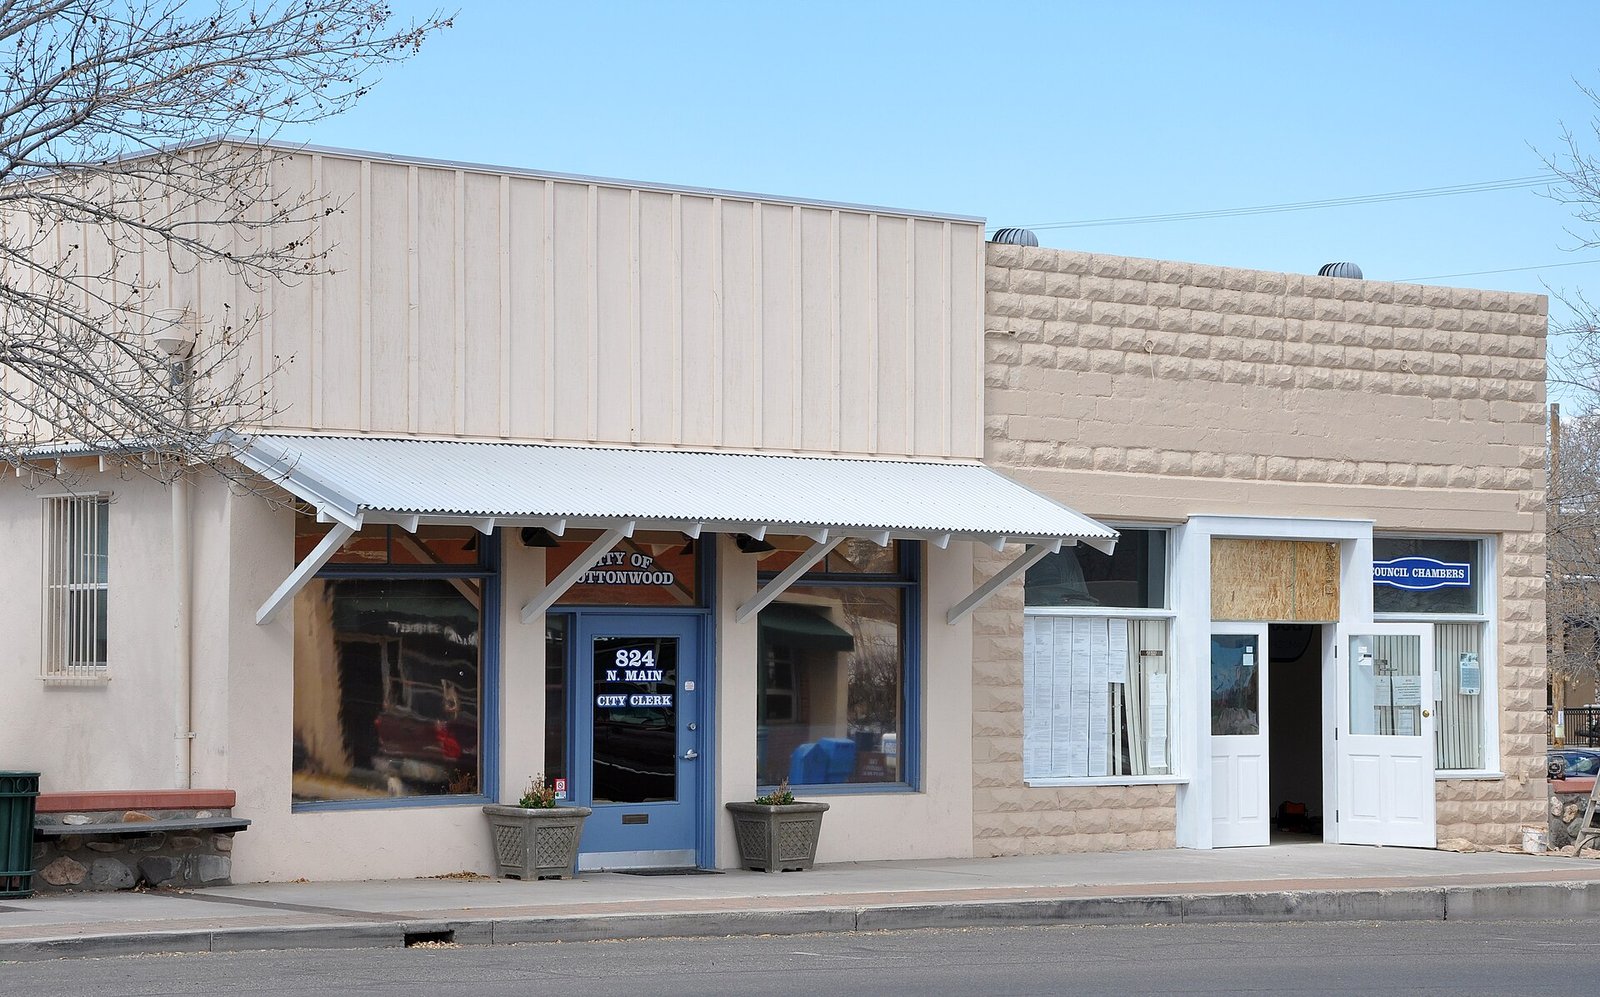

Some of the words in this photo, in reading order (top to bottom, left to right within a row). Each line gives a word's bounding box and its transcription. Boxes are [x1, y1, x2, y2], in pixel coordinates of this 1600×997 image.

[594, 552, 625, 567] ITY
[631, 553, 653, 568] OF
[576, 570, 674, 585] OTTONWOOD
[1372, 566, 1409, 578] OUNCIL
[1412, 568, 1465, 579] CHAMBERS
[615, 649, 655, 667] 824
[606, 670, 620, 681] N.
[625, 670, 663, 681] MAIN
[597, 695, 626, 706] CITY
[630, 695, 671, 706] CLERK
